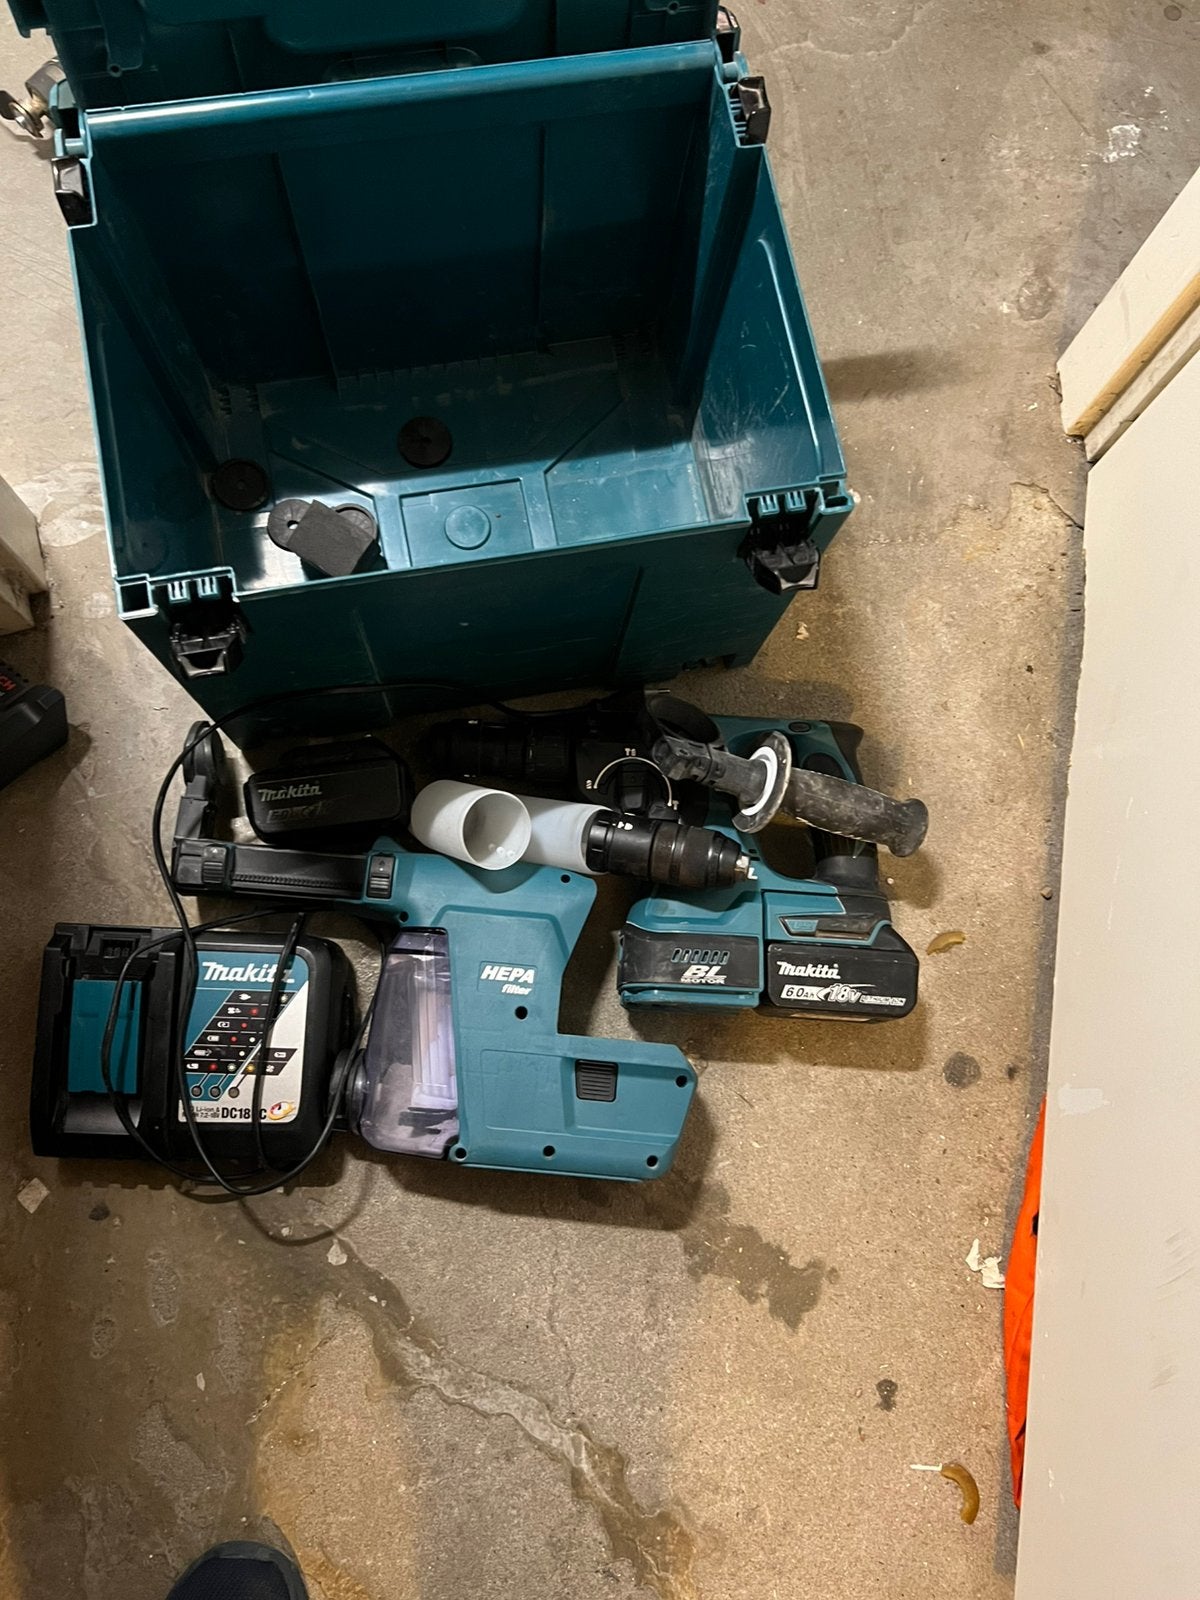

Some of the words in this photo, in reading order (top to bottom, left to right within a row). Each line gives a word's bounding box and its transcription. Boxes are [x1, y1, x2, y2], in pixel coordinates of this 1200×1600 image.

[258, 783, 322, 802] Makita
[480, 964, 535, 984] HEPA
[682, 964, 727, 979] BL
[776, 961, 841, 980] Makita
[680, 977, 725, 985] MOTOR
[501, 983, 532, 995] filter
[221, 1106, 267, 1120] DC18C
